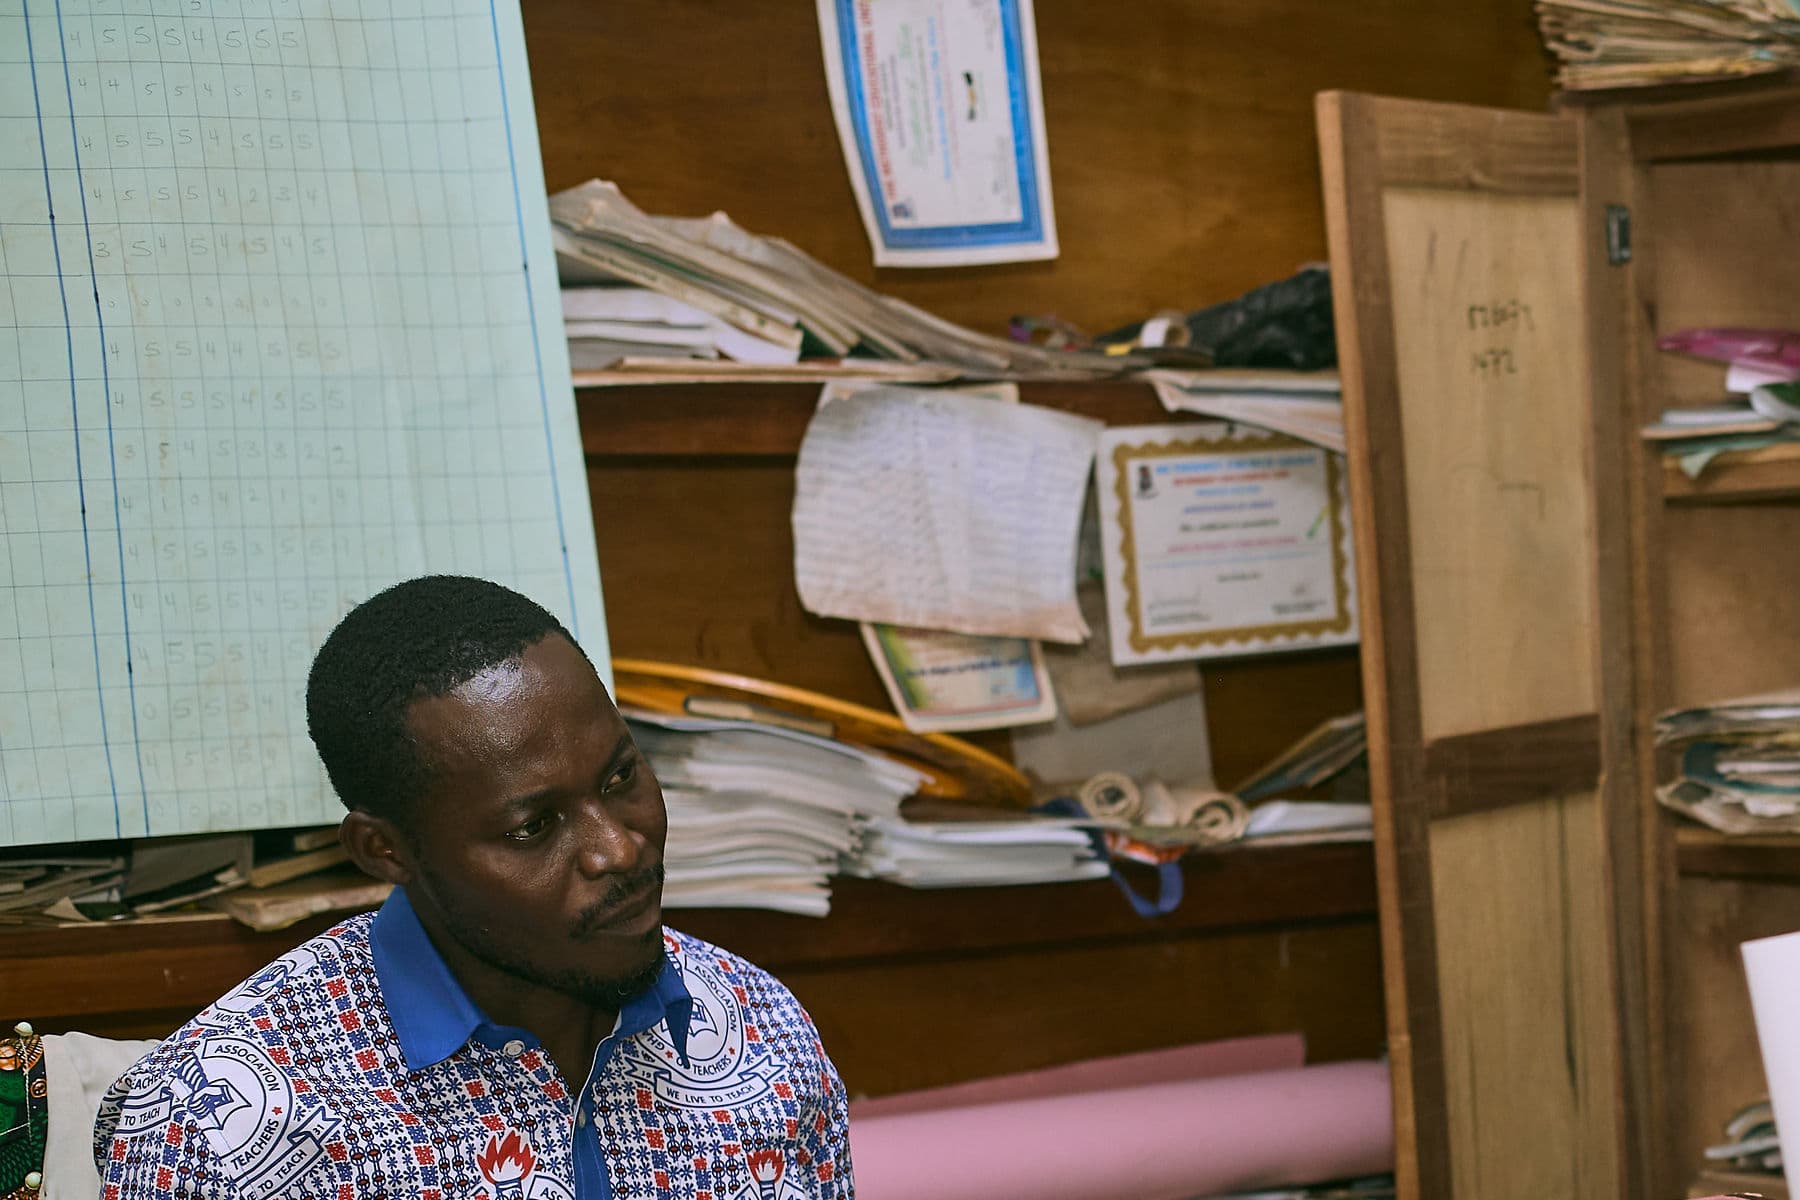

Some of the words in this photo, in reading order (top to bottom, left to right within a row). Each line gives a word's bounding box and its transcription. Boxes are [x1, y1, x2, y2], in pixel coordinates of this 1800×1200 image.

[694, 966, 738, 1032] ASSOCIATION
[214, 1044, 281, 1093] ASSOCIATION
[693, 1055, 733, 1076] TEACHERS
[666, 1086, 680, 1100] WE
[685, 1093, 706, 1105] LIVE
[710, 1094, 723, 1103] TO
[725, 1084, 756, 1101] TEACH
[124, 1115, 136, 1126] TO
[140, 1106, 161, 1124] TEACH
[312, 1123, 326, 1137] 31
[230, 1118, 279, 1171] TEACHERS
[257, 1178, 274, 1194] TO
[274, 1149, 308, 1181] TEACH
